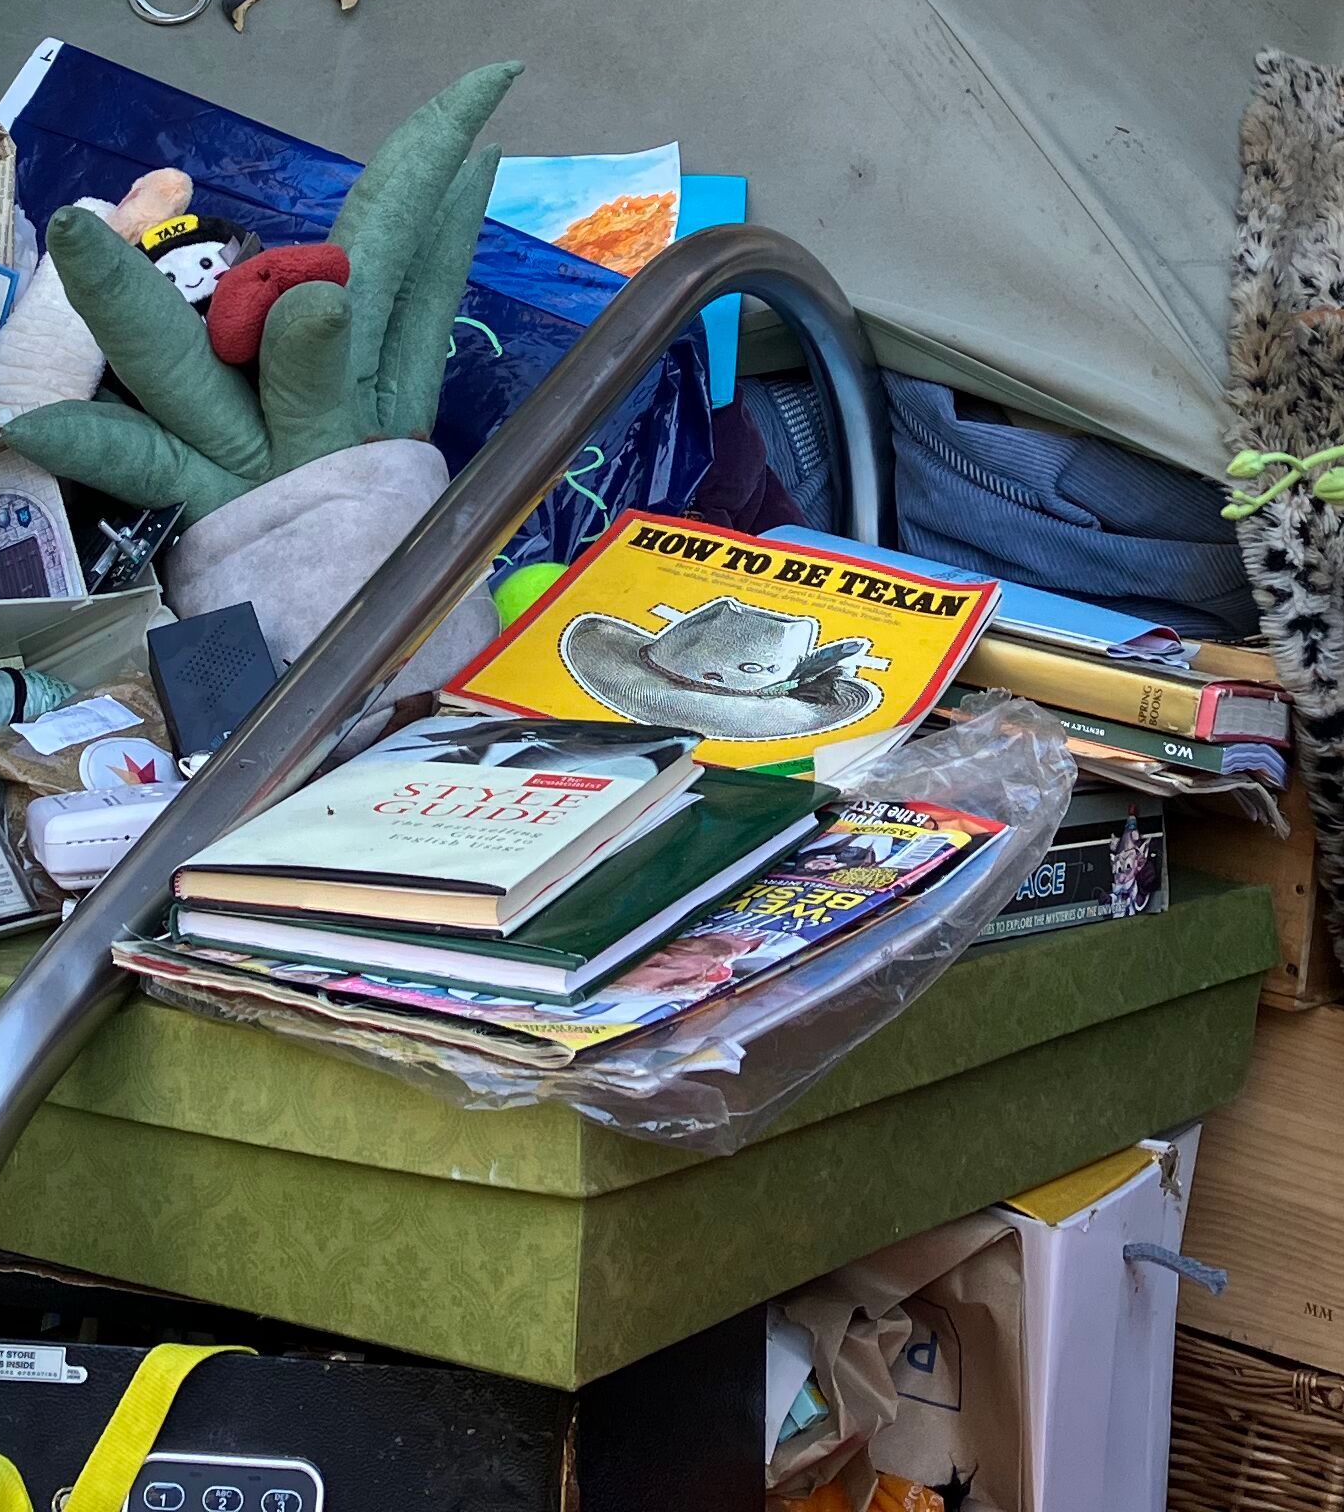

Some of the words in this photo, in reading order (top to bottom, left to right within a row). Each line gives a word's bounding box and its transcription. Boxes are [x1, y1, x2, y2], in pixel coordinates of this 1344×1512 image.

[154, 222, 186, 240] TAXI
[628, 526, 724, 563] HOW
[720, 545, 773, 576] TO
[773, 558, 834, 589] BE
[837, 569, 972, 618] TEXAN
[1138, 684, 1153, 725] SPRING
[1149, 687, 1164, 727] BOOKS
[1071, 722, 1106, 737] BENTLEY
[1163, 741, 1194, 760] W.O.
[531, 779, 603, 789] Economist
[560, 775, 585, 783] The
[393, 782, 590, 809] STYLE
[372, 799, 568, 826] GUIDE
[887, 804, 914, 823] the
[915, 812, 931, 828] is
[391, 819, 424, 828] The
[431, 822, 544, 839] Best-selling
[450, 830, 508, 843] Guide
[513, 836, 534, 845] to
[850, 826, 918, 840] FASHION
[389, 833, 460, 846] English
[469, 841, 526, 853] Usage
[797, 887, 867, 911] BE
[996, 920, 1006, 934] TO
[1006, 915, 1034, 932] EXPLORE
[1034, 913, 1046, 926] THE
[1045, 908, 1077, 925] MYSTERIES
[1076, 906, 1086, 921] OF
[1086, 905, 1098, 918] THE
[1303, 1301, 1334, 1322] MM
[6, 1350, 36, 1360] STORE
[6, 1361, 35, 1370] INSIDE
[159, 1492, 166, 1508] 1
[215, 1489, 232, 1498] ABC
[274, 1493, 290, 1501] DEF
[218, 1498, 227, 1511] 2
[277, 1500, 287, 1512] 3
